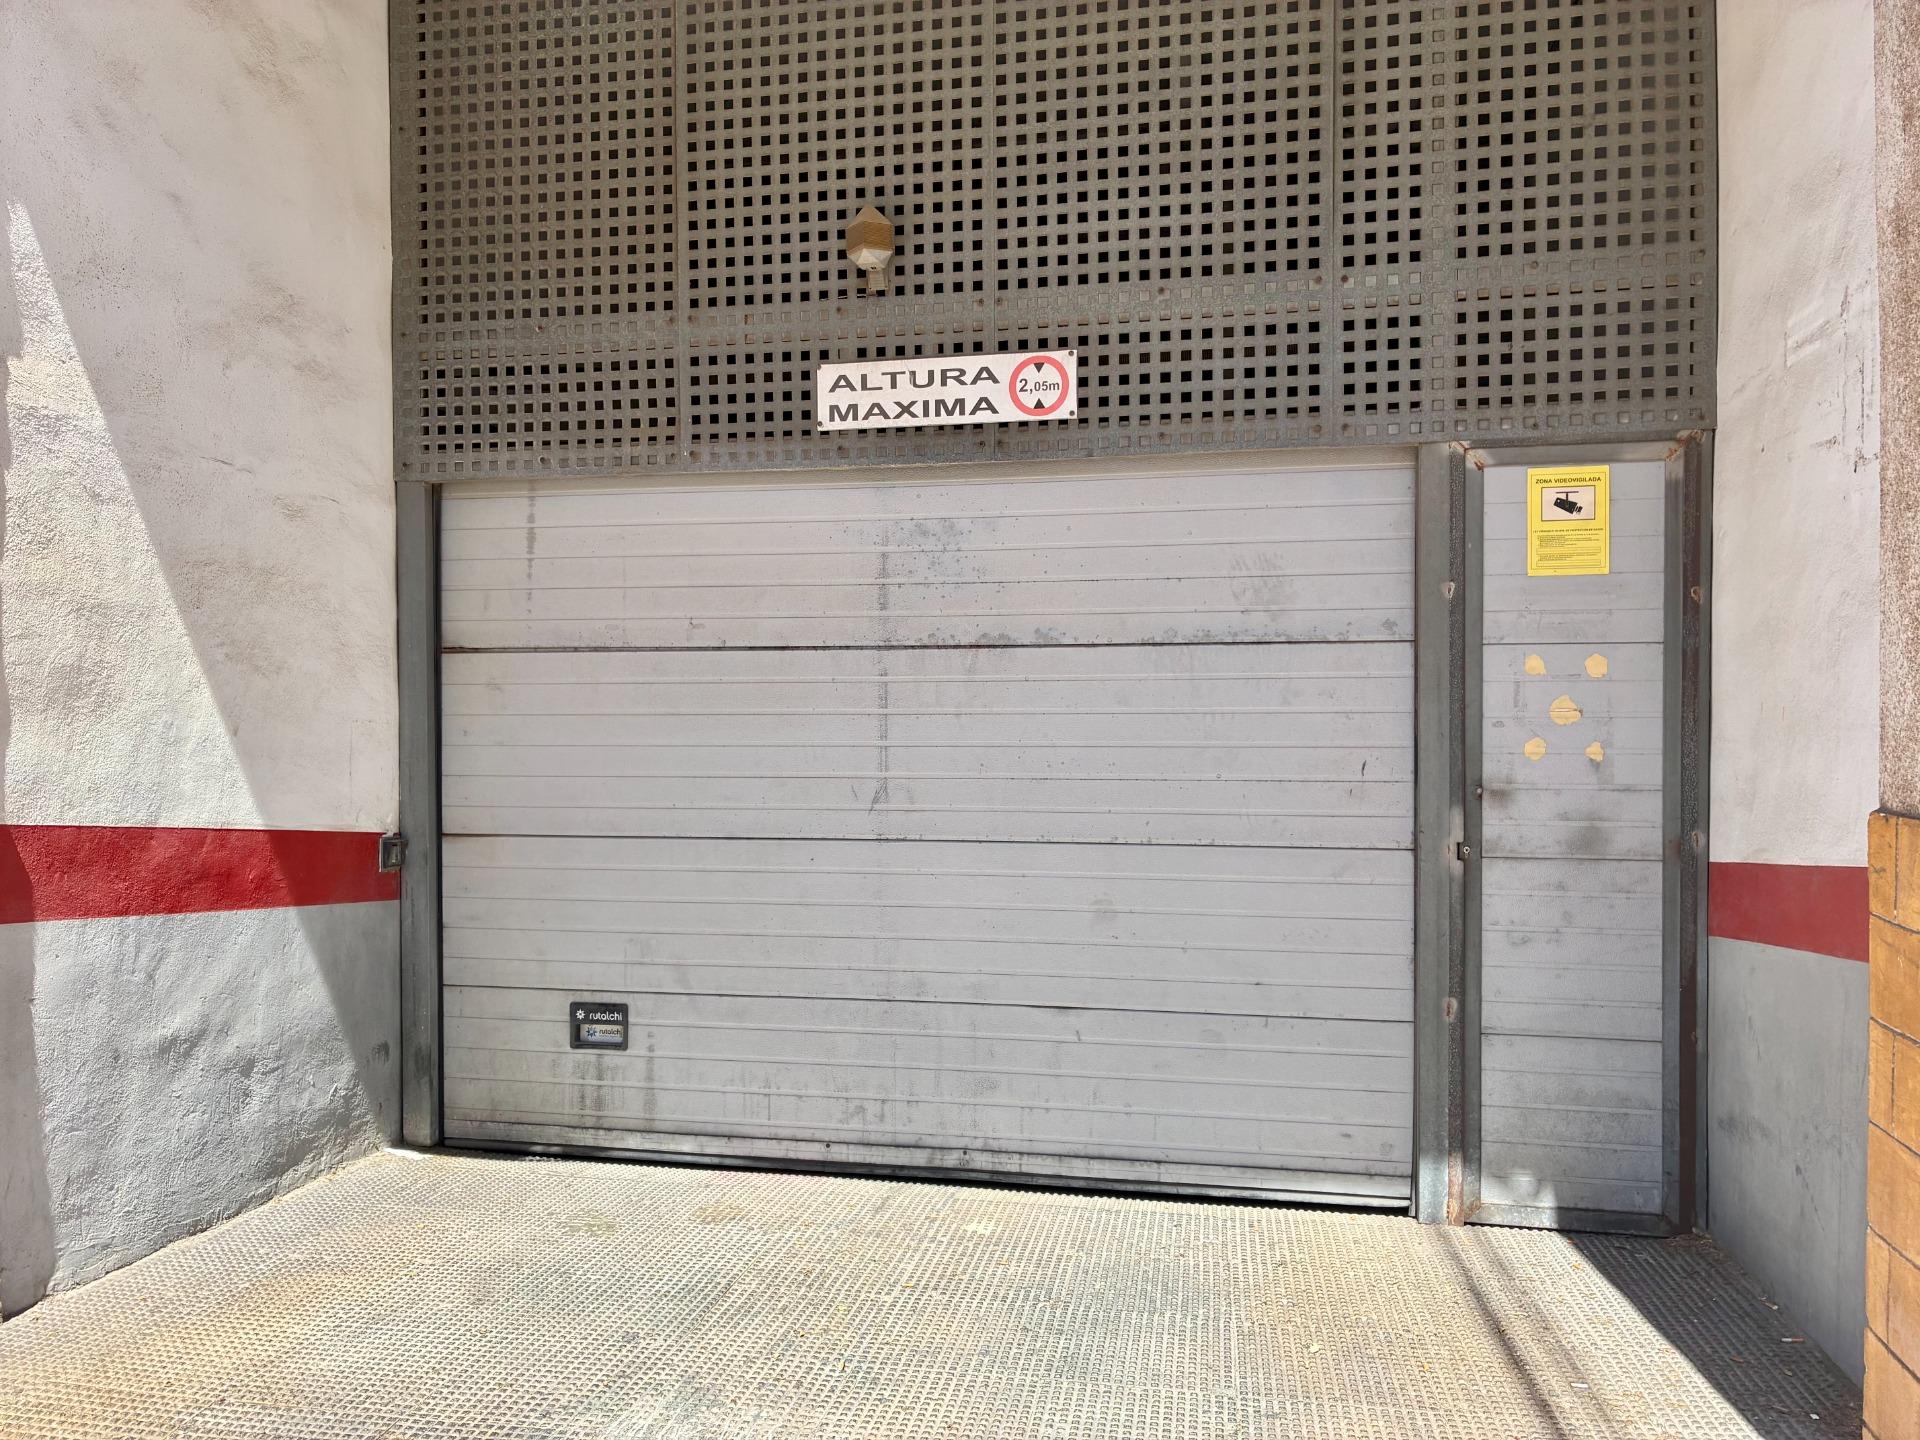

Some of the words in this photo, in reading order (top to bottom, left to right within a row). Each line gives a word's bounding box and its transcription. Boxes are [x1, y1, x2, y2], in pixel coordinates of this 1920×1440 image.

[828, 366, 1000, 393] ALTURA
[1018, 378, 1060, 394] 2,05m
[828, 396, 1000, 422] MAXIMA
[1554, 476, 1602, 484] VIDEOVIGILADA
[589, 1011, 623, 1021] rutalchi
